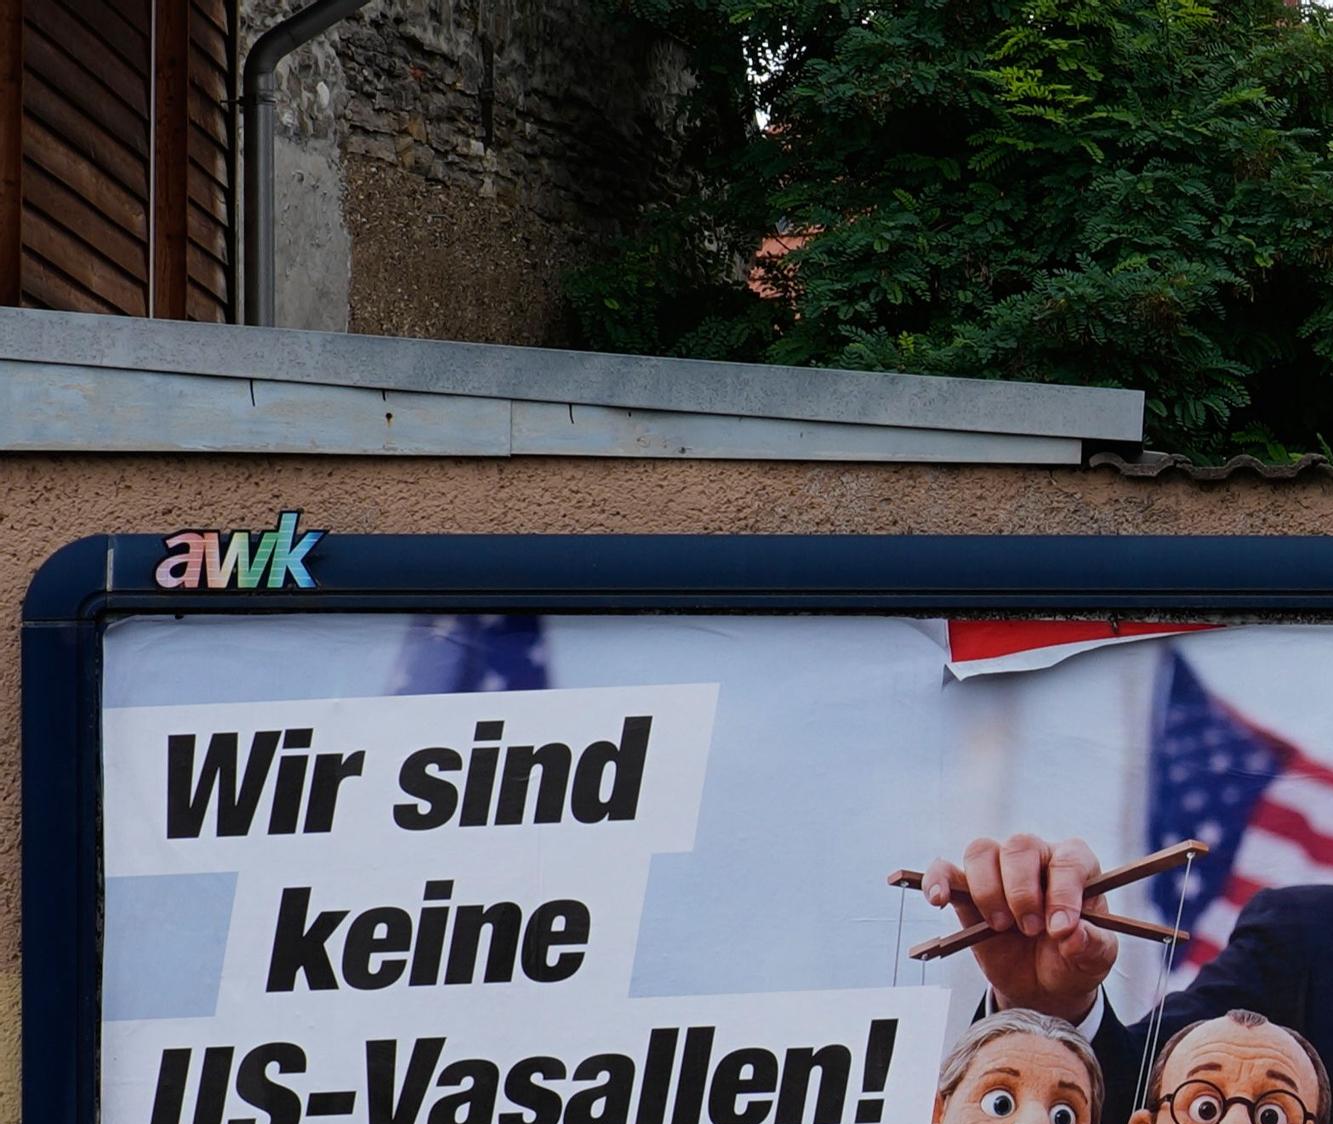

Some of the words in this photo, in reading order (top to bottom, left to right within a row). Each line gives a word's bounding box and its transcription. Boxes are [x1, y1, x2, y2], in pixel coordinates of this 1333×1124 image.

[155, 511, 328, 590] awk
[167, 729, 364, 840] Wir
[392, 715, 653, 831] sind
[266, 880, 590, 993] keine
